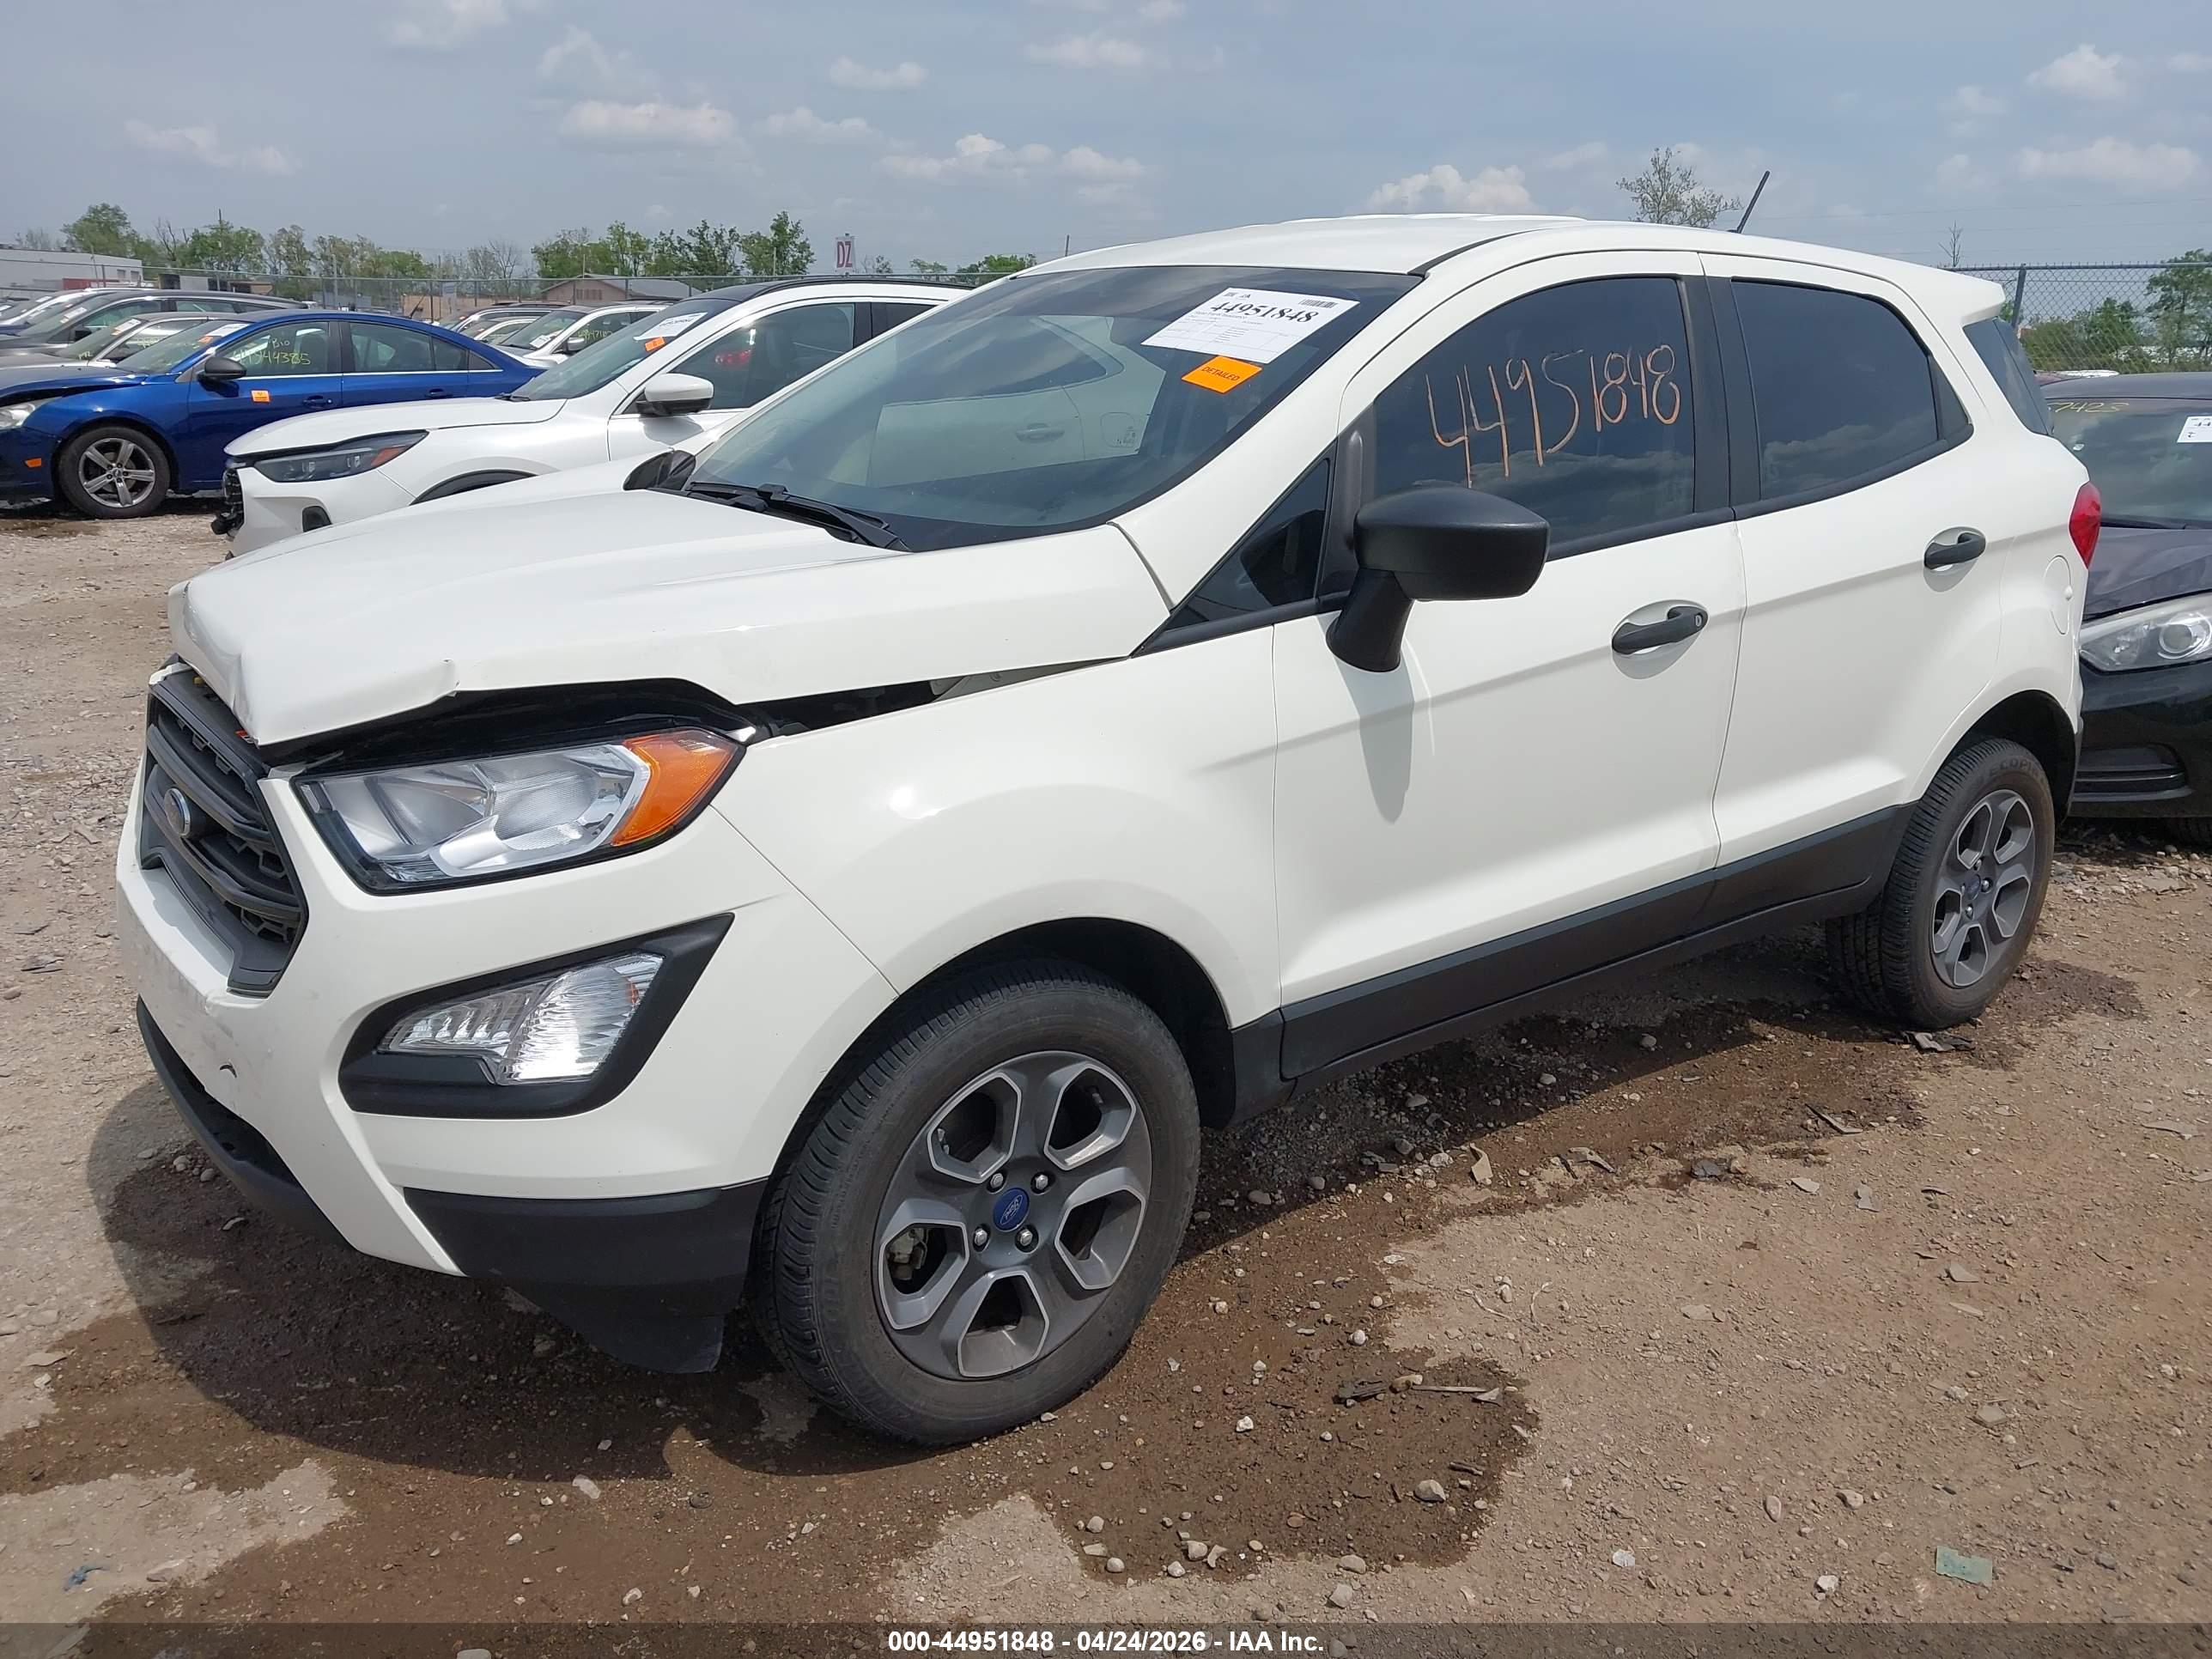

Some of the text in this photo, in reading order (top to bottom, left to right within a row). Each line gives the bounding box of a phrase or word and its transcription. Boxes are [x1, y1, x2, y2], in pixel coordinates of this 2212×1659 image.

[836, 240, 854, 268] DZ
[1210, 301, 1319, 323] 44951848
[1201, 366, 1241, 381] DETAILED
[1425, 343, 1681, 489] 44951848
